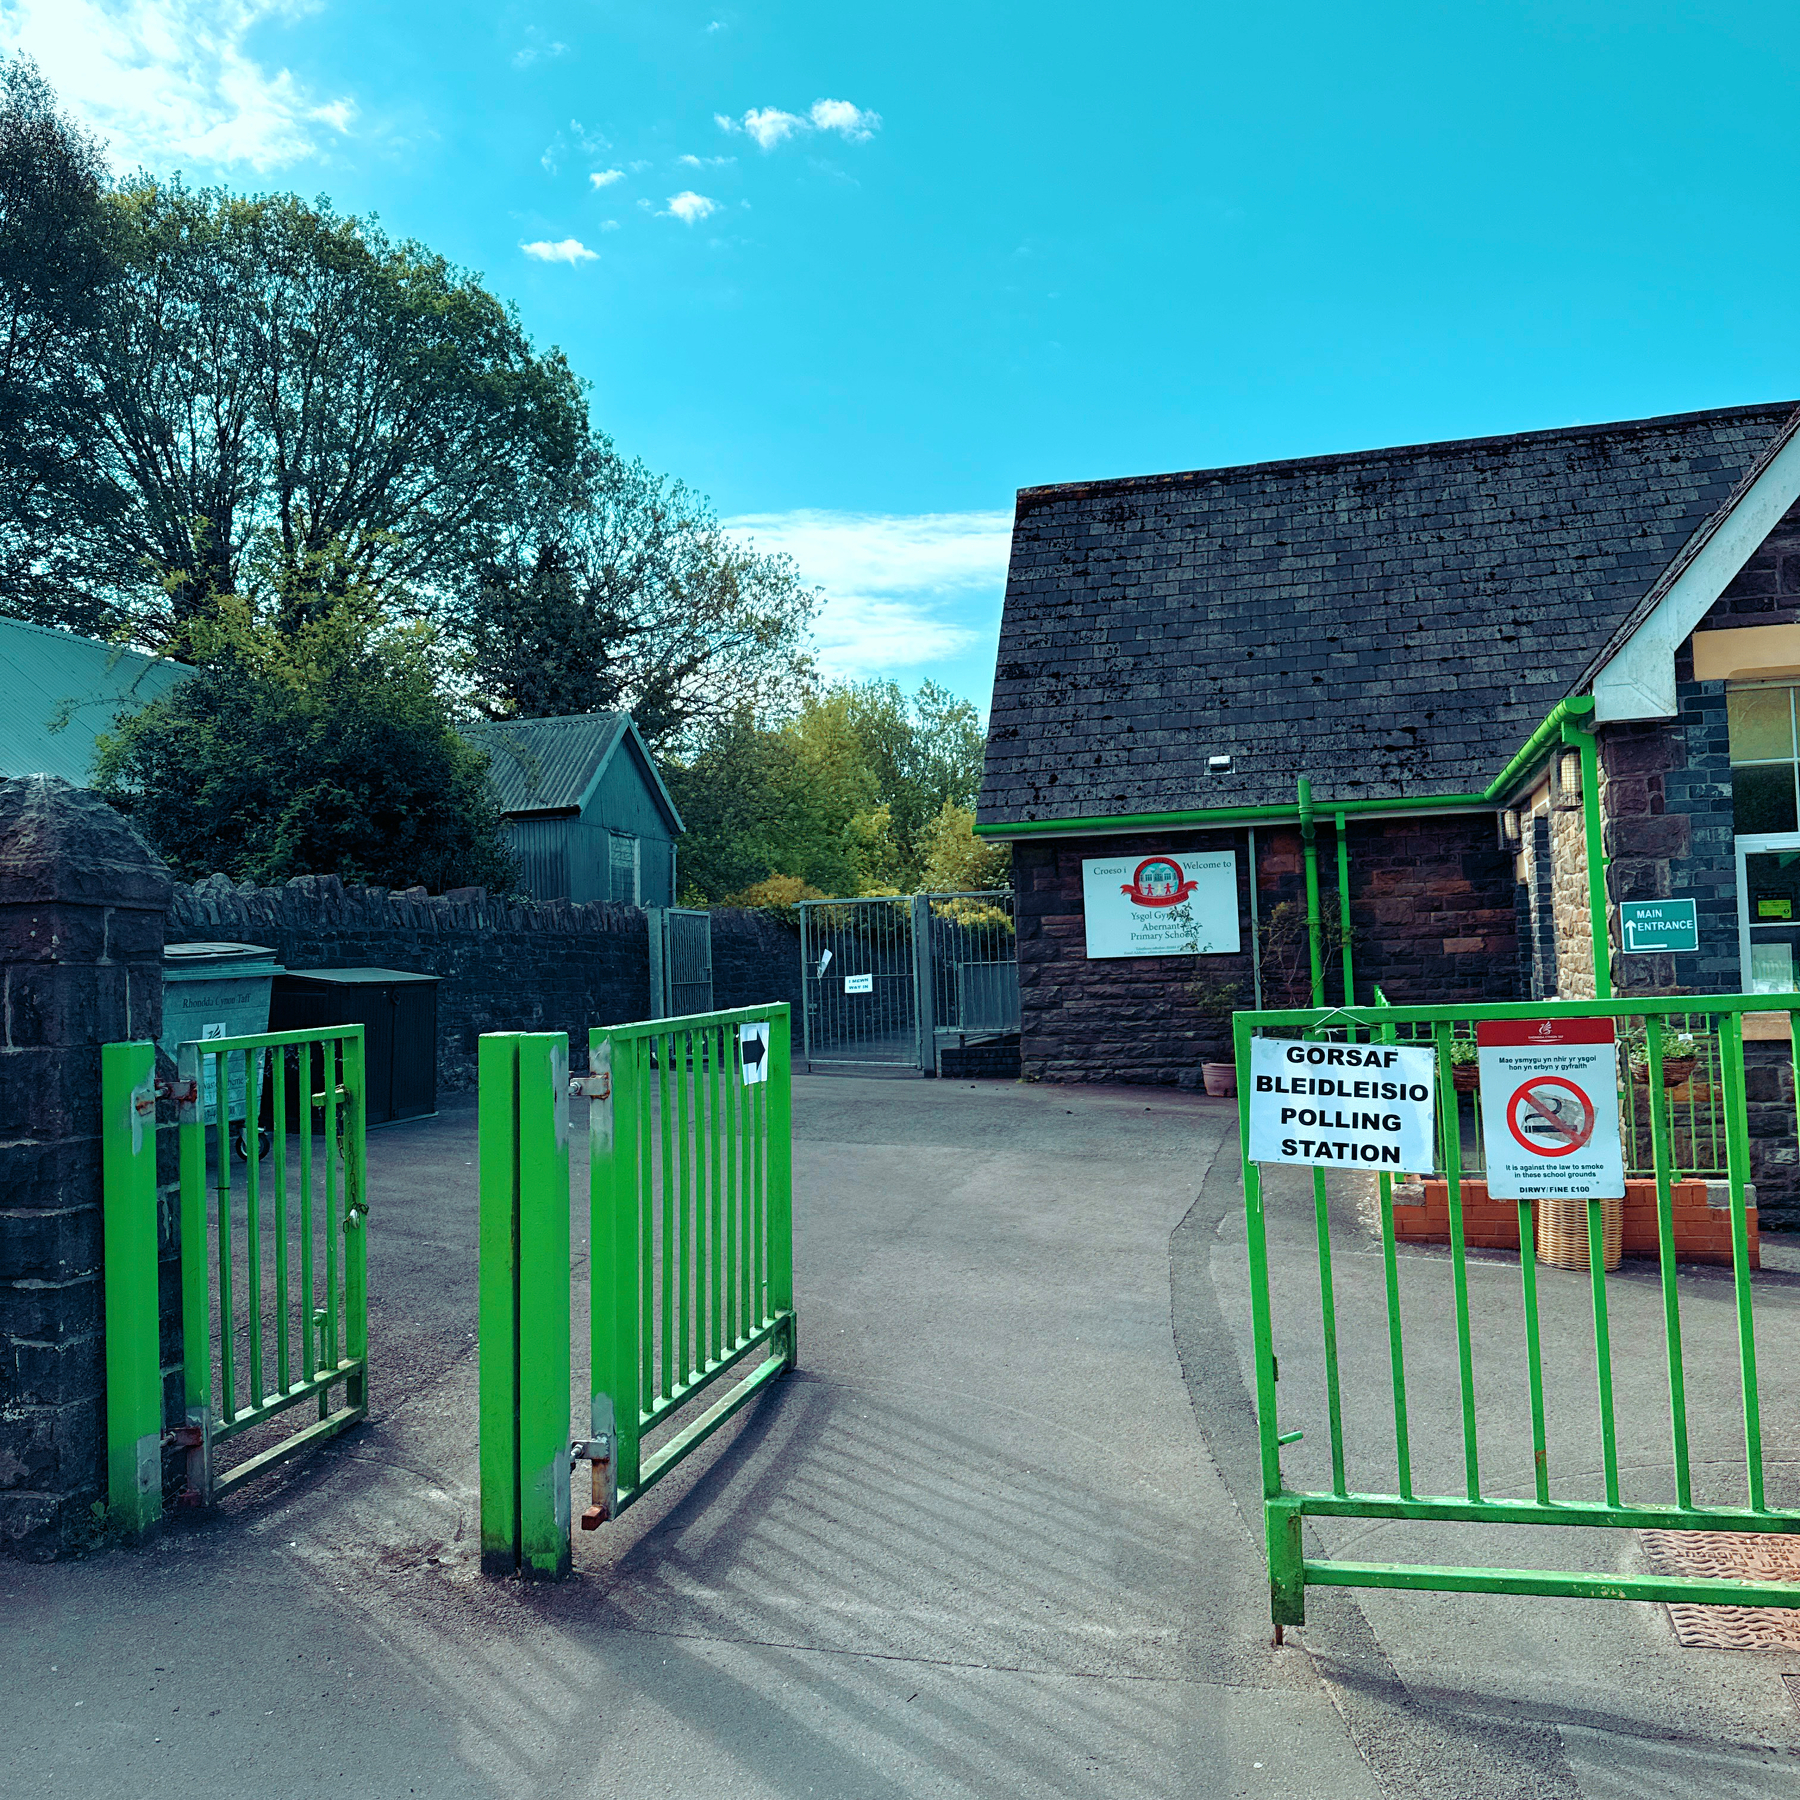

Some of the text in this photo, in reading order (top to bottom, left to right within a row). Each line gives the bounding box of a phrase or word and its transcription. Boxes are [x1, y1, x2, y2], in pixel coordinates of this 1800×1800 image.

[1183, 861, 1221, 870] Welcome
[1093, 867, 1122, 875] Croeso
[1131, 911, 1152, 922] Ysgol
[1636, 909, 1663, 919] MAIN
[1142, 923, 1180, 931] Abernant
[1637, 920, 1694, 932] ENTRANCE
[1131, 932, 1163, 941] Primary
[182, 997, 214, 1008] Rhondda
[237, 993, 251, 1003] Taff
[1286, 1046, 1399, 1068] GORSAF
[1515, 1057, 1542, 1065] ysmygu
[1577, 1055, 1596, 1063] ysgol
[1561, 1063, 1587, 1071] gyfraith
[1256, 1075, 1429, 1101] BLEIDLEISIO
[1281, 1107, 1402, 1132] POLLING
[1281, 1139, 1401, 1163] STATION
[1520, 1164, 1545, 1172] against
[1568, 1171, 1596, 1179] grounds
